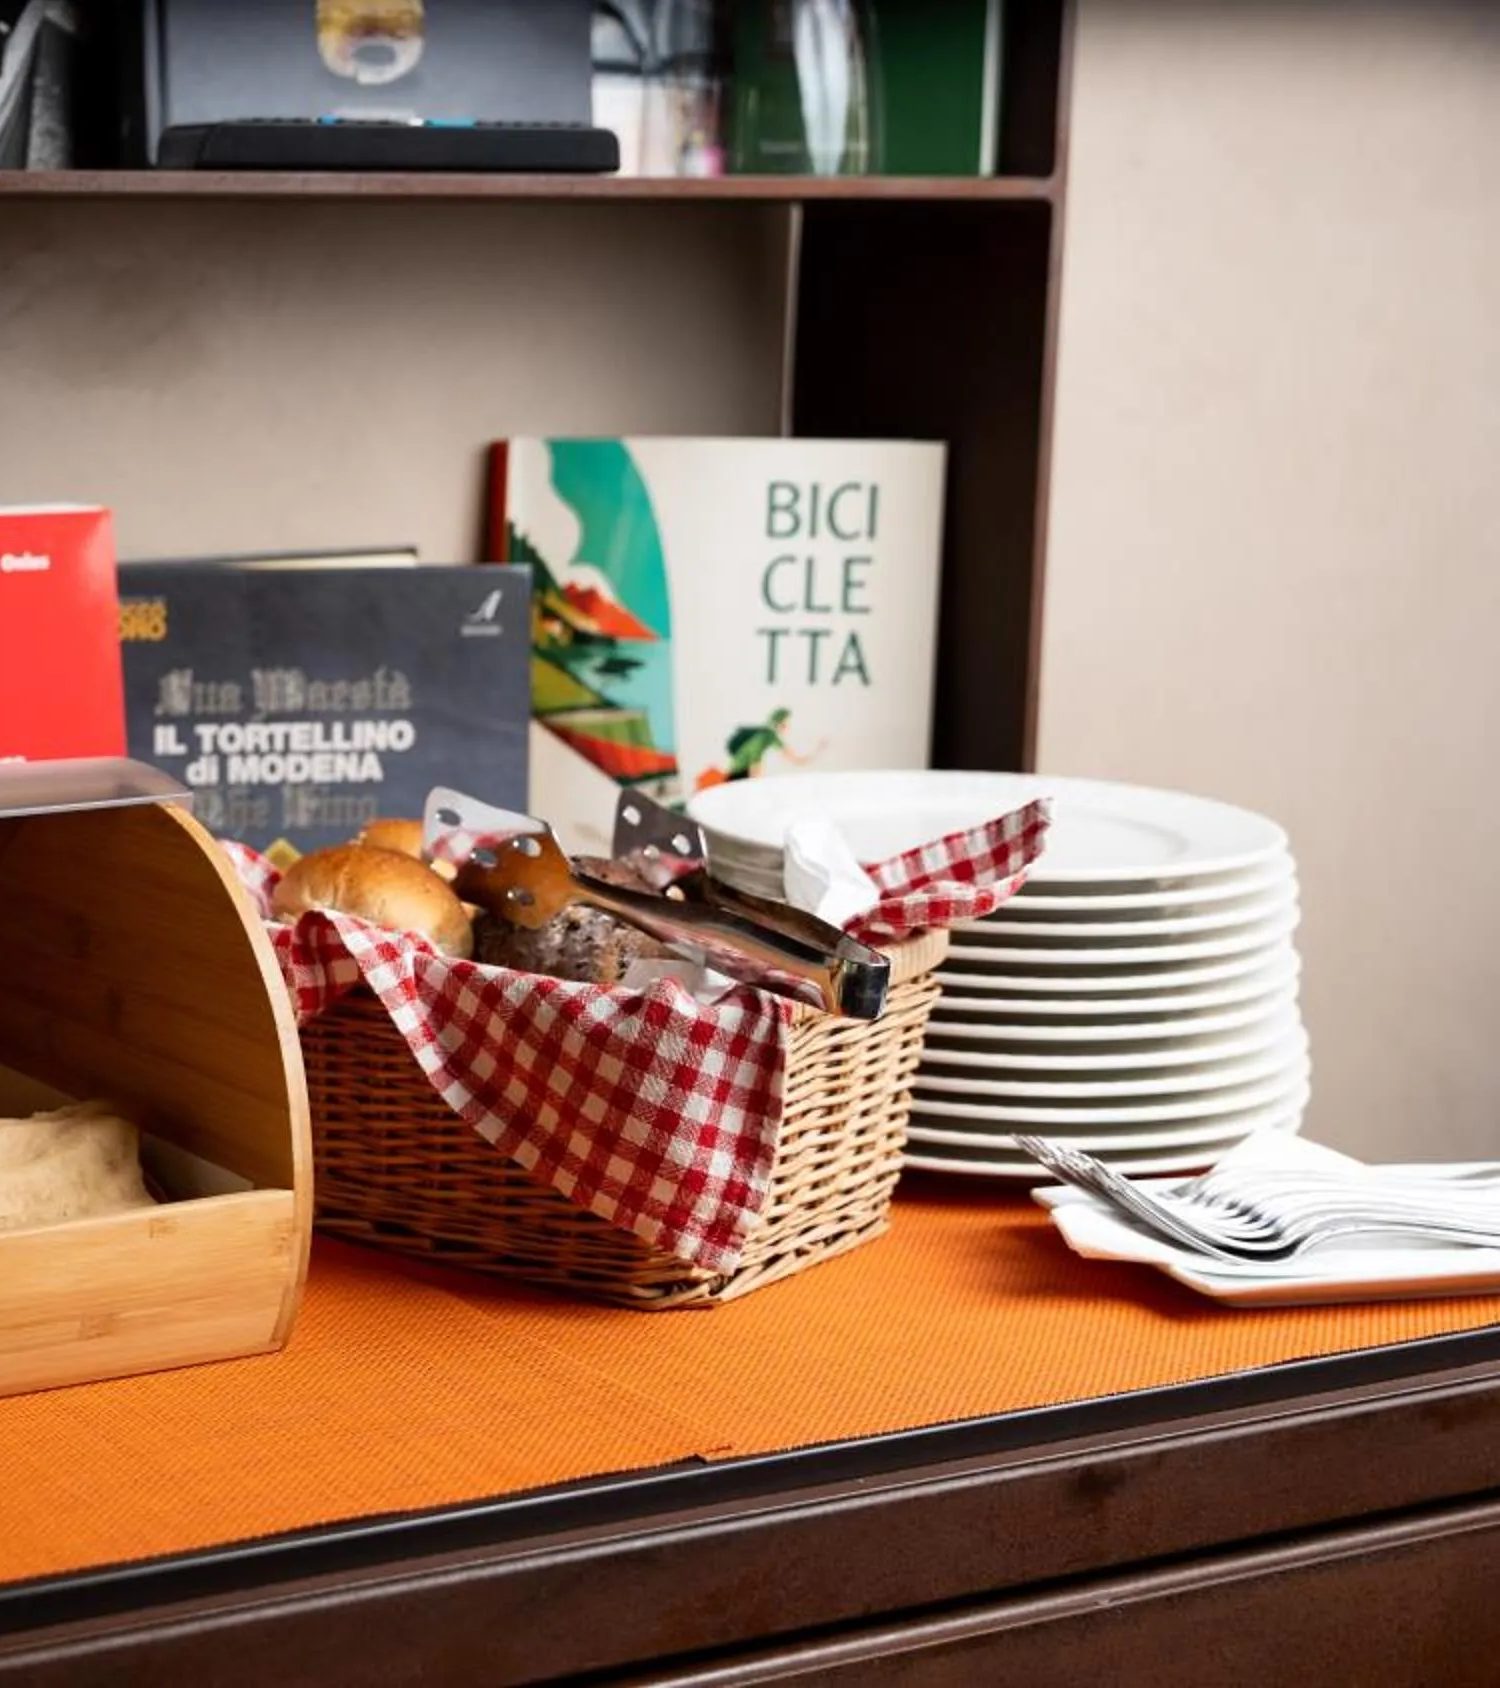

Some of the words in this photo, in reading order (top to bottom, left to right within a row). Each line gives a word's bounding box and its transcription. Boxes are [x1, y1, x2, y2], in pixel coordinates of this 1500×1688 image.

[765, 481, 879, 541] BICI
[762, 555, 872, 614] CLE
[757, 628, 871, 687] TTA
[153, 724, 188, 755] IL
[195, 720, 416, 754] TORTELLINO
[185, 754, 219, 786] di
[226, 752, 384, 785] MODENA
